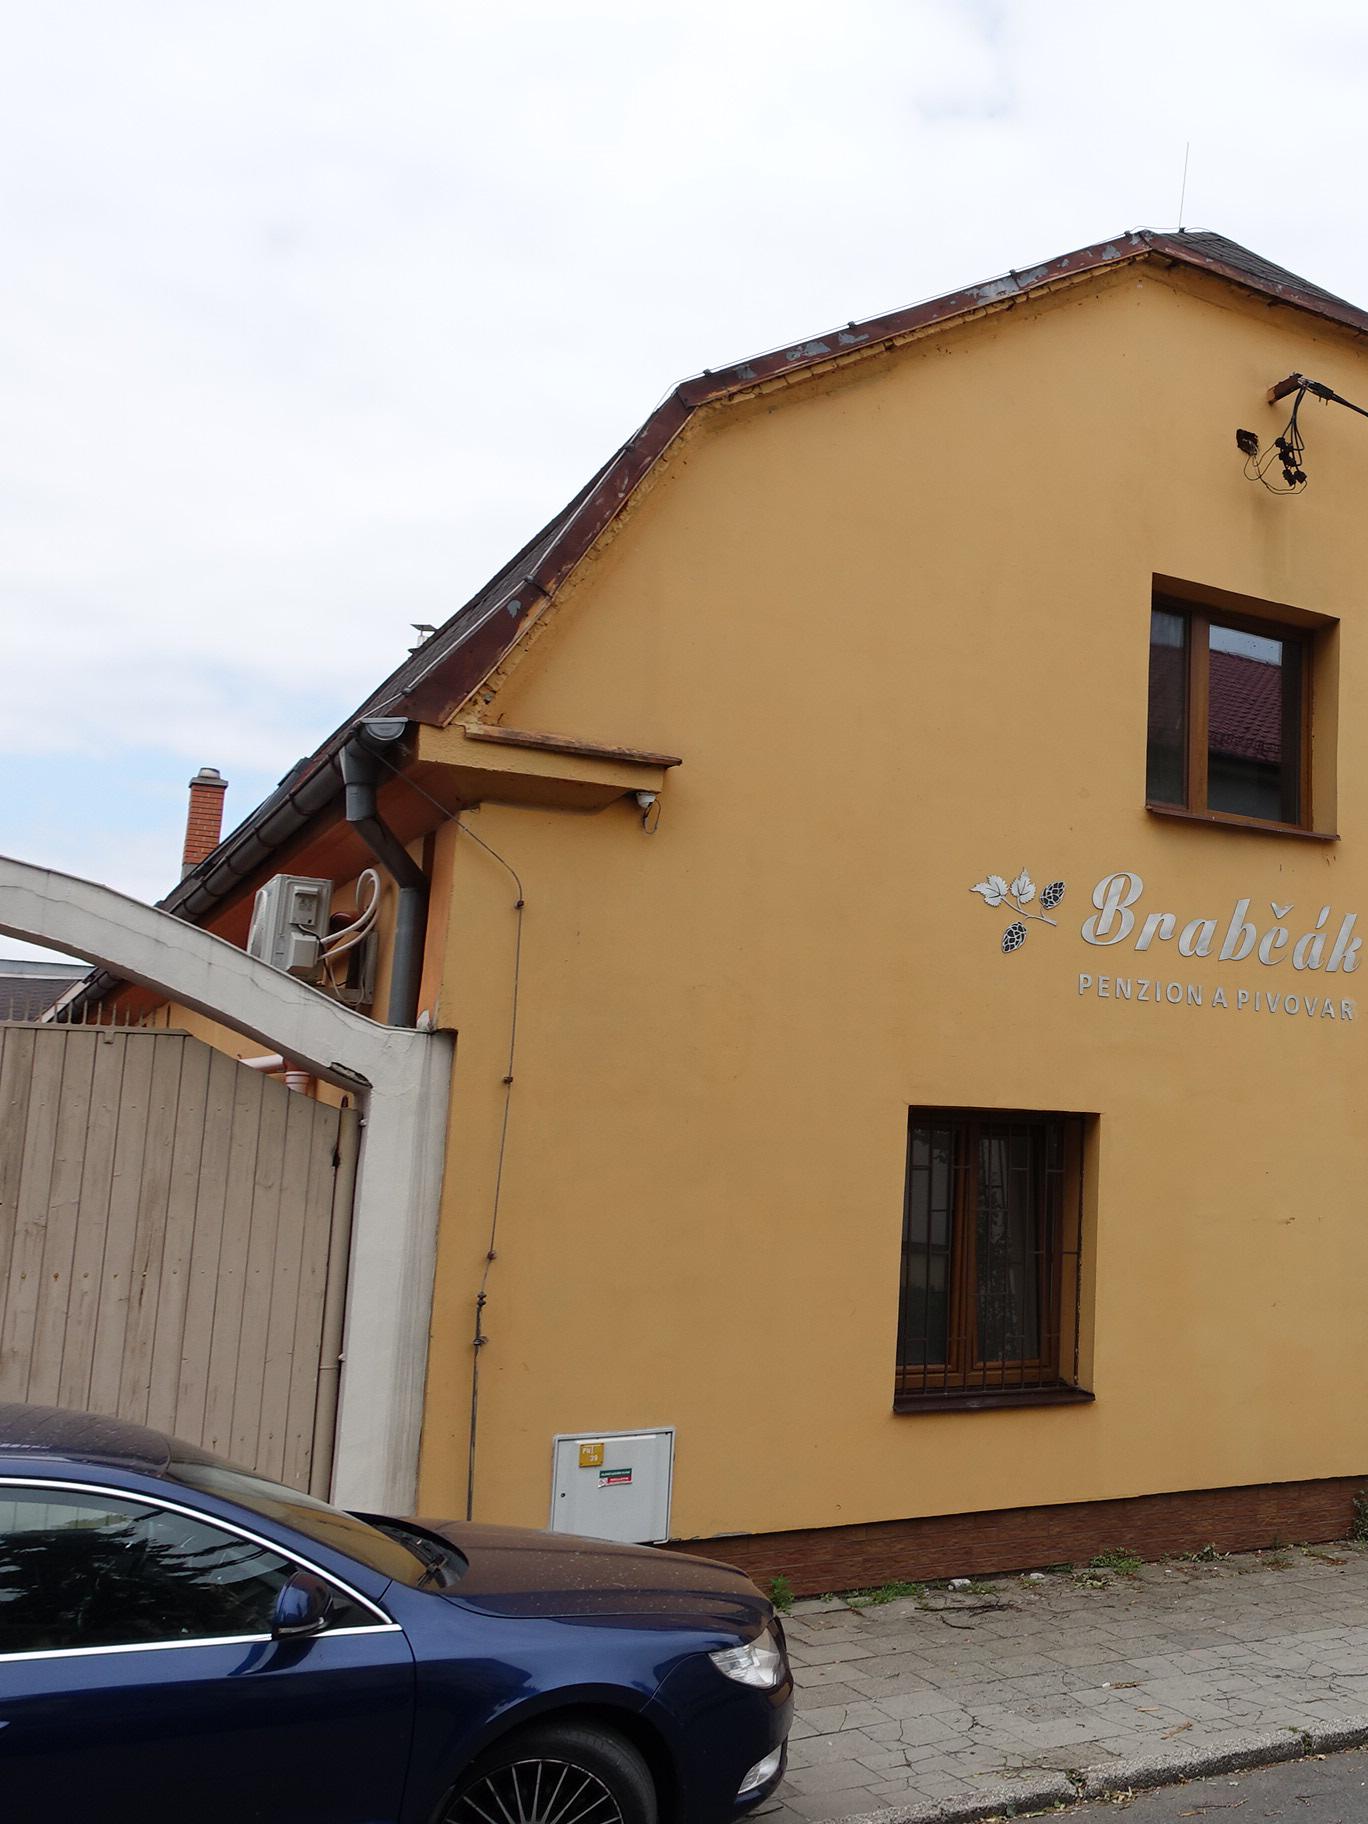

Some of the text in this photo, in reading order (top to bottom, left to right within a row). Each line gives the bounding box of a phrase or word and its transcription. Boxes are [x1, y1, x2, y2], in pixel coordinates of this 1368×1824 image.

[1080, 871, 1363, 974] Brabčák
[1079, 973, 1355, 1021] PENZION A PIVOVAR
